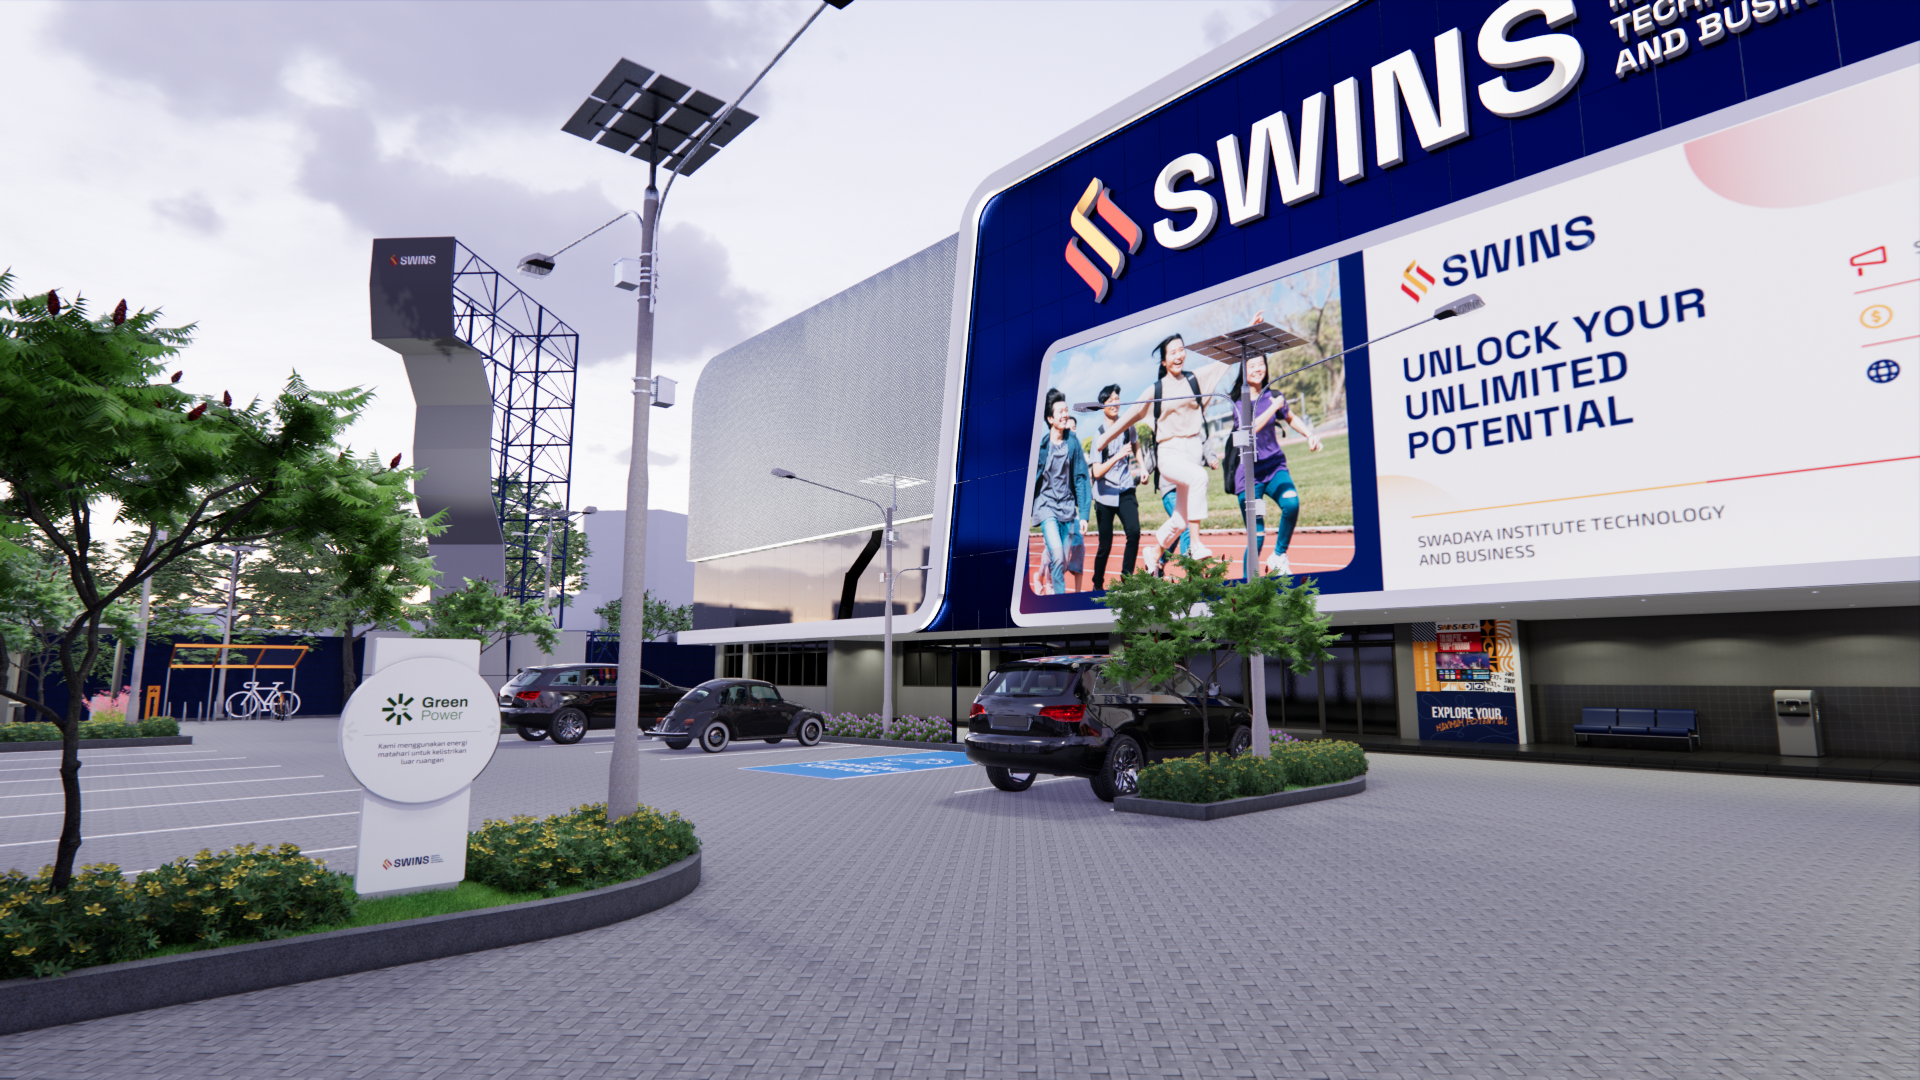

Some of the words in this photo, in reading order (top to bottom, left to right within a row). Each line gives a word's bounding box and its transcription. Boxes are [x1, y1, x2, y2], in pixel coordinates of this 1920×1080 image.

[1615, 27, 1689, 79] AND
[1153, 0, 1585, 250] SWINS
[1443, 215, 1596, 287] SWINS
[400, 255, 437, 266] SWINS
[1403, 321, 1561, 383] UNLOCK
[1572, 288, 1706, 343] YOUR
[1405, 351, 1628, 420] UNLIMITED
[1408, 395, 1634, 459] POTENTIAL
[1417, 529, 1493, 548] SWADAYA
[1496, 519, 1587, 540] INSTITUTE
[1590, 505, 1726, 532] TECHNOLOGY
[1419, 551, 1452, 567] AND
[1455, 544, 1536, 564] BUSINESS
[422, 696, 468, 708] Green
[421, 710, 463, 721] Power
[1431, 706, 1474, 719] EXPLORE
[1475, 707, 1502, 720] YOUR
[378, 750, 410, 758] matahari
[411, 749, 431, 757] untuk
[397, 741, 446, 749] menggunakan
[416, 757, 445, 765] ruangan
[394, 855, 430, 868] SWINS
